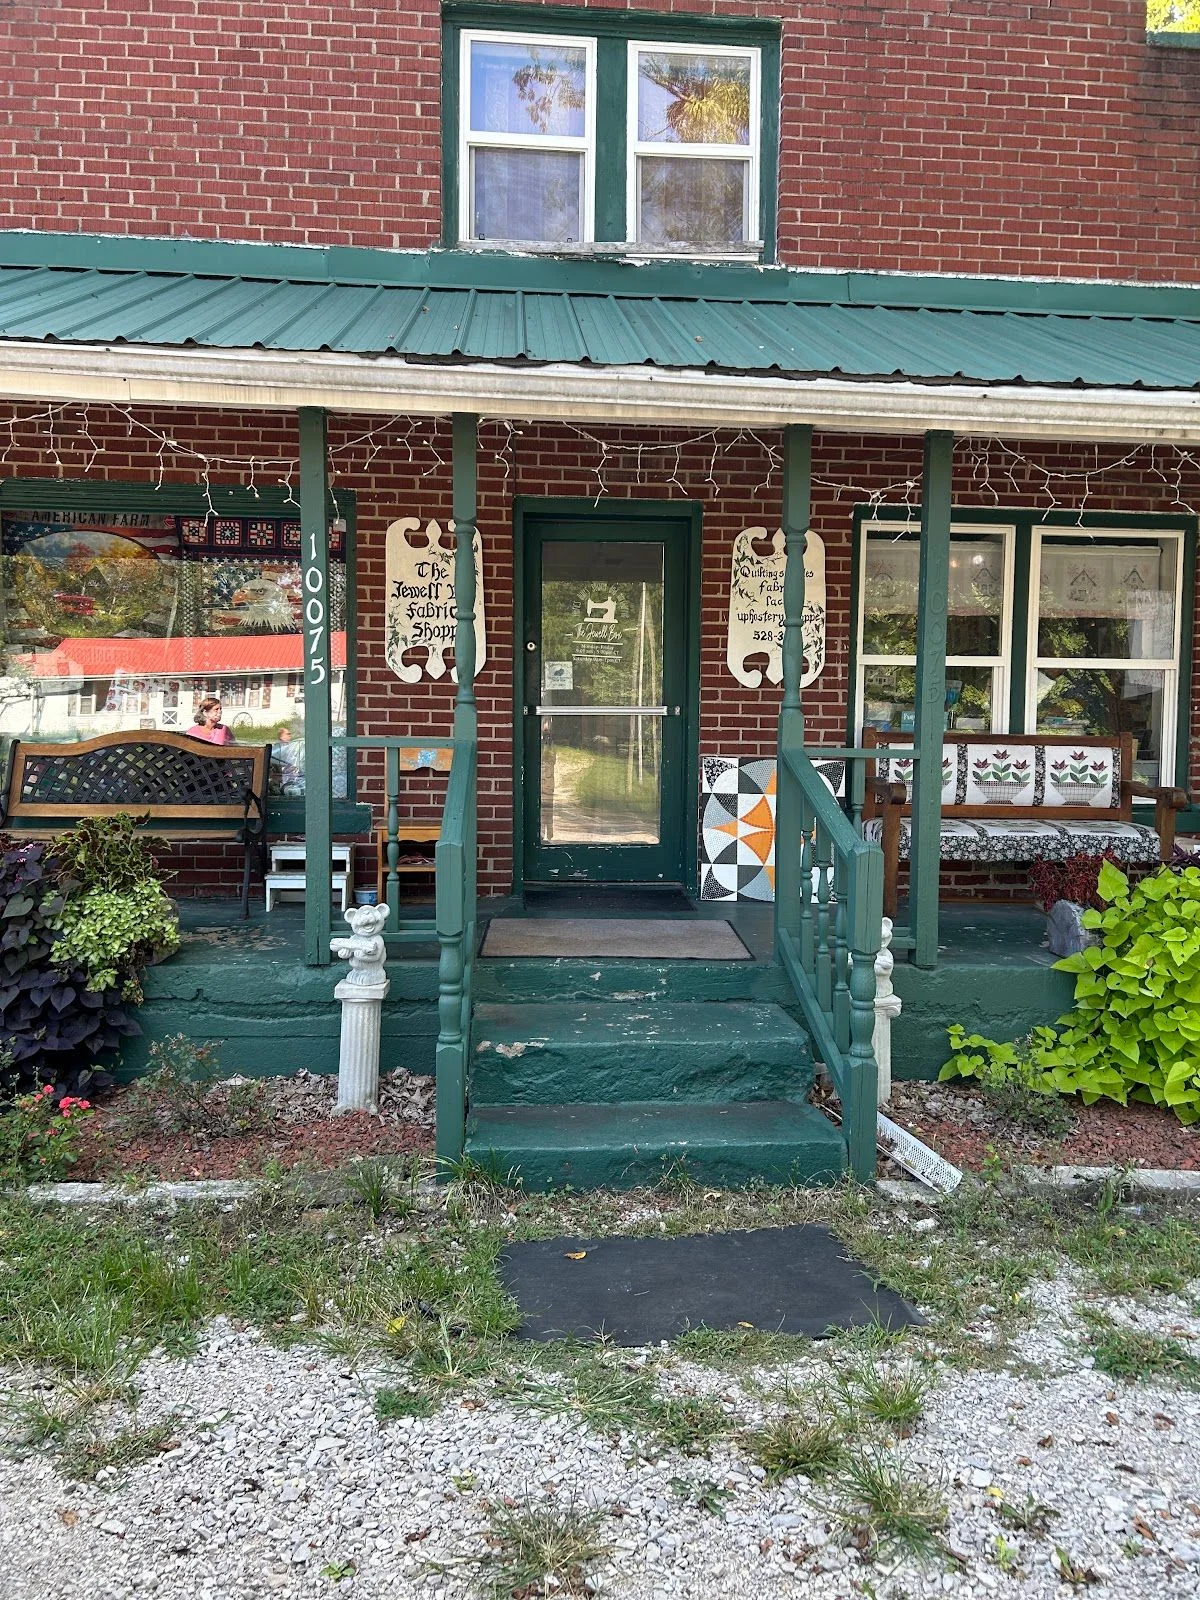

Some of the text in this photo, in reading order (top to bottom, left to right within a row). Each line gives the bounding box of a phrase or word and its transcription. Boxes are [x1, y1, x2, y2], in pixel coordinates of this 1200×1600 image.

[31, 511, 150, 526] AMERICAN FARM
[415, 562, 449, 580] The
[391, 580, 442, 600] Jewell
[305, 532, 326, 685] 10075
[766, 595, 783, 606] lac
[406, 601, 458, 620] Fabric
[412, 622, 457, 644] Shopp
